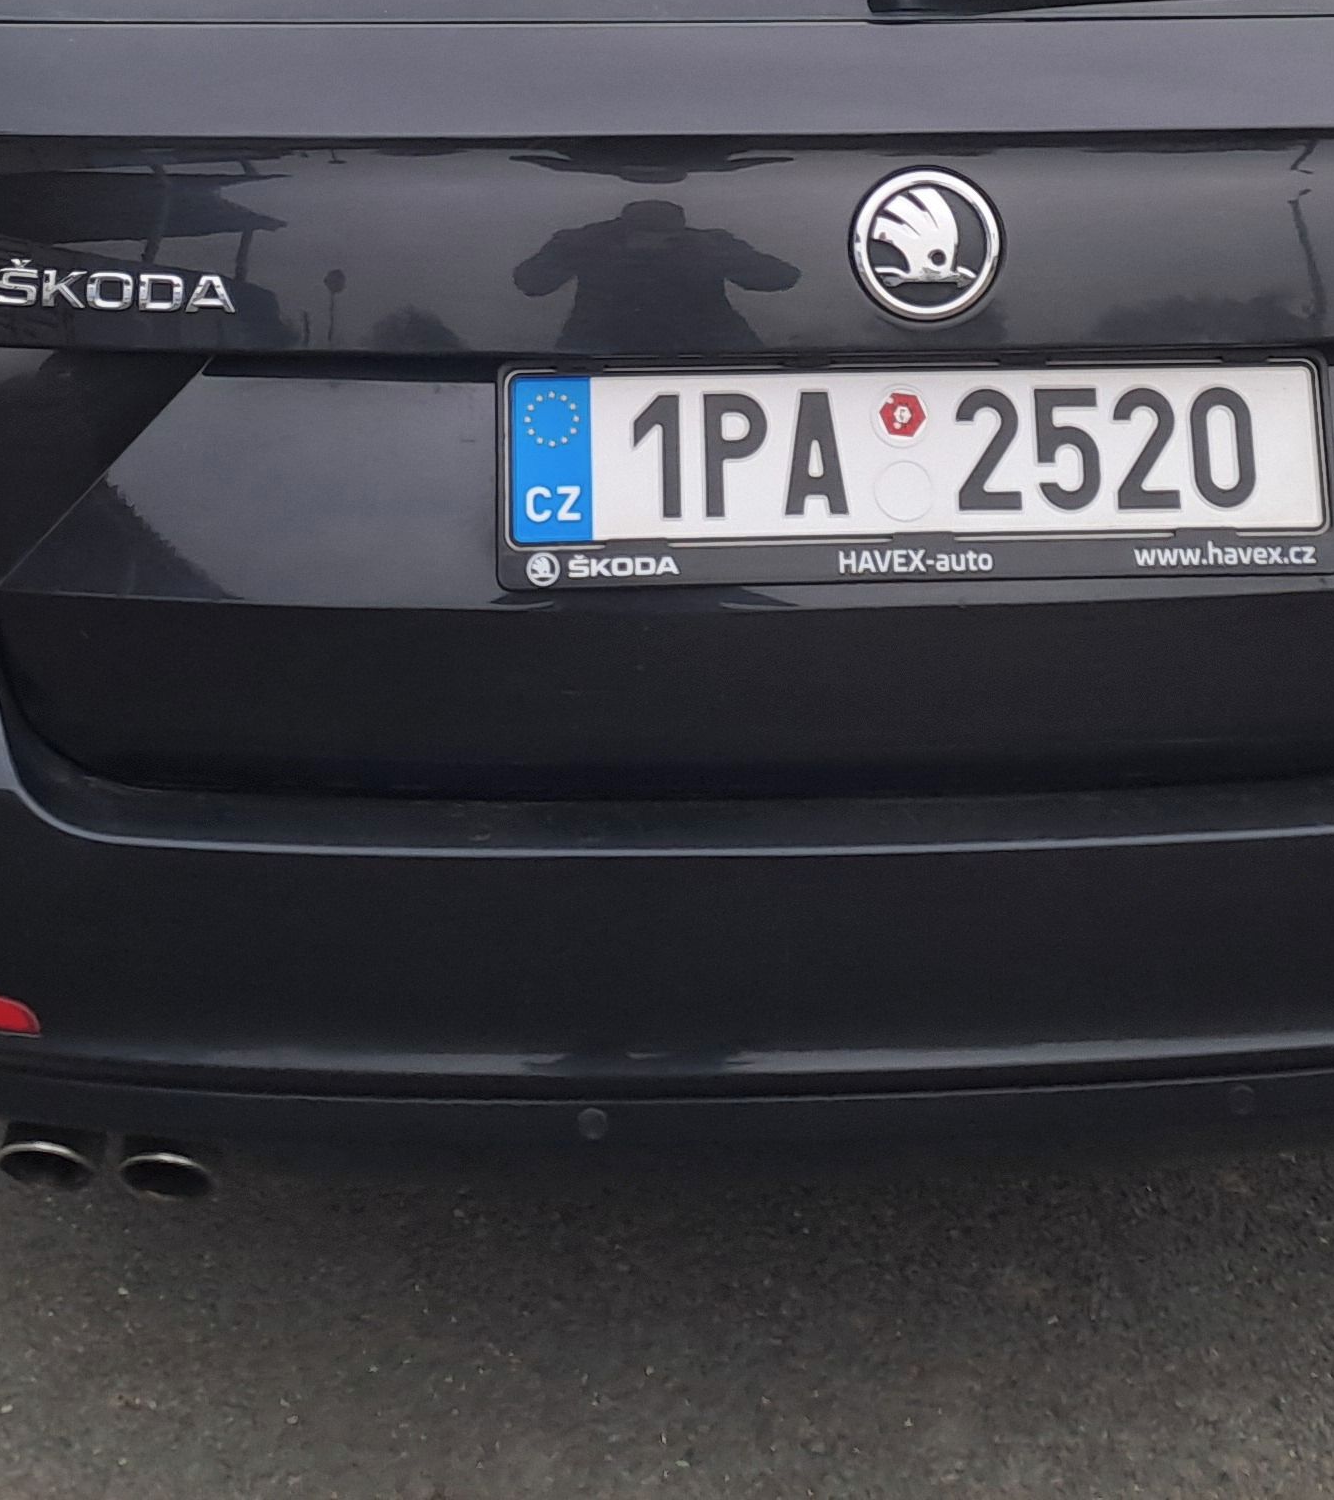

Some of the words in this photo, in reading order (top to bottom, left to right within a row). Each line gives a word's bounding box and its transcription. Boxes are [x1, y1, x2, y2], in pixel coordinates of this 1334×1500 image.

[630, 390, 851, 520] 1PA
[953, 384, 1257, 512] 2520
[524, 484, 582, 523] CZ
[567, 554, 681, 579] ŠKODA
[838, 548, 994, 576] HAVEX-auto
[1132, 540, 1318, 568] www.havex.cz
